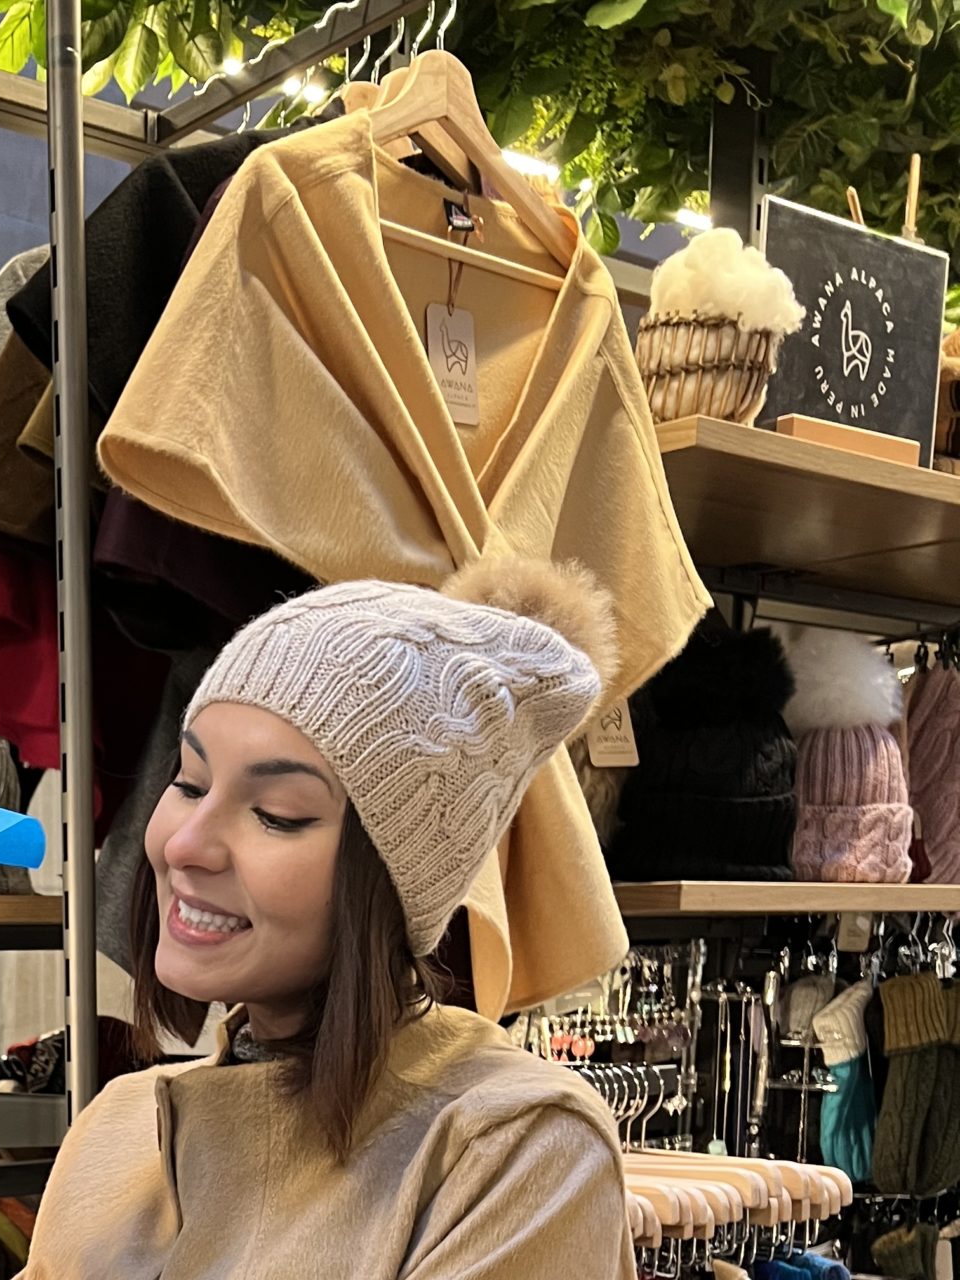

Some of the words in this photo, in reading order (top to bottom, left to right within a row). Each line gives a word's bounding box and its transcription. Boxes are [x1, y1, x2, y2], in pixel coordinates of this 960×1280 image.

[811, 272, 843, 347] AWANA
[851, 267, 894, 333] ALPACA
[814, 366, 843, 414] PERU
[870, 348, 895, 408] MADE
[850, 403, 865, 418] IN
